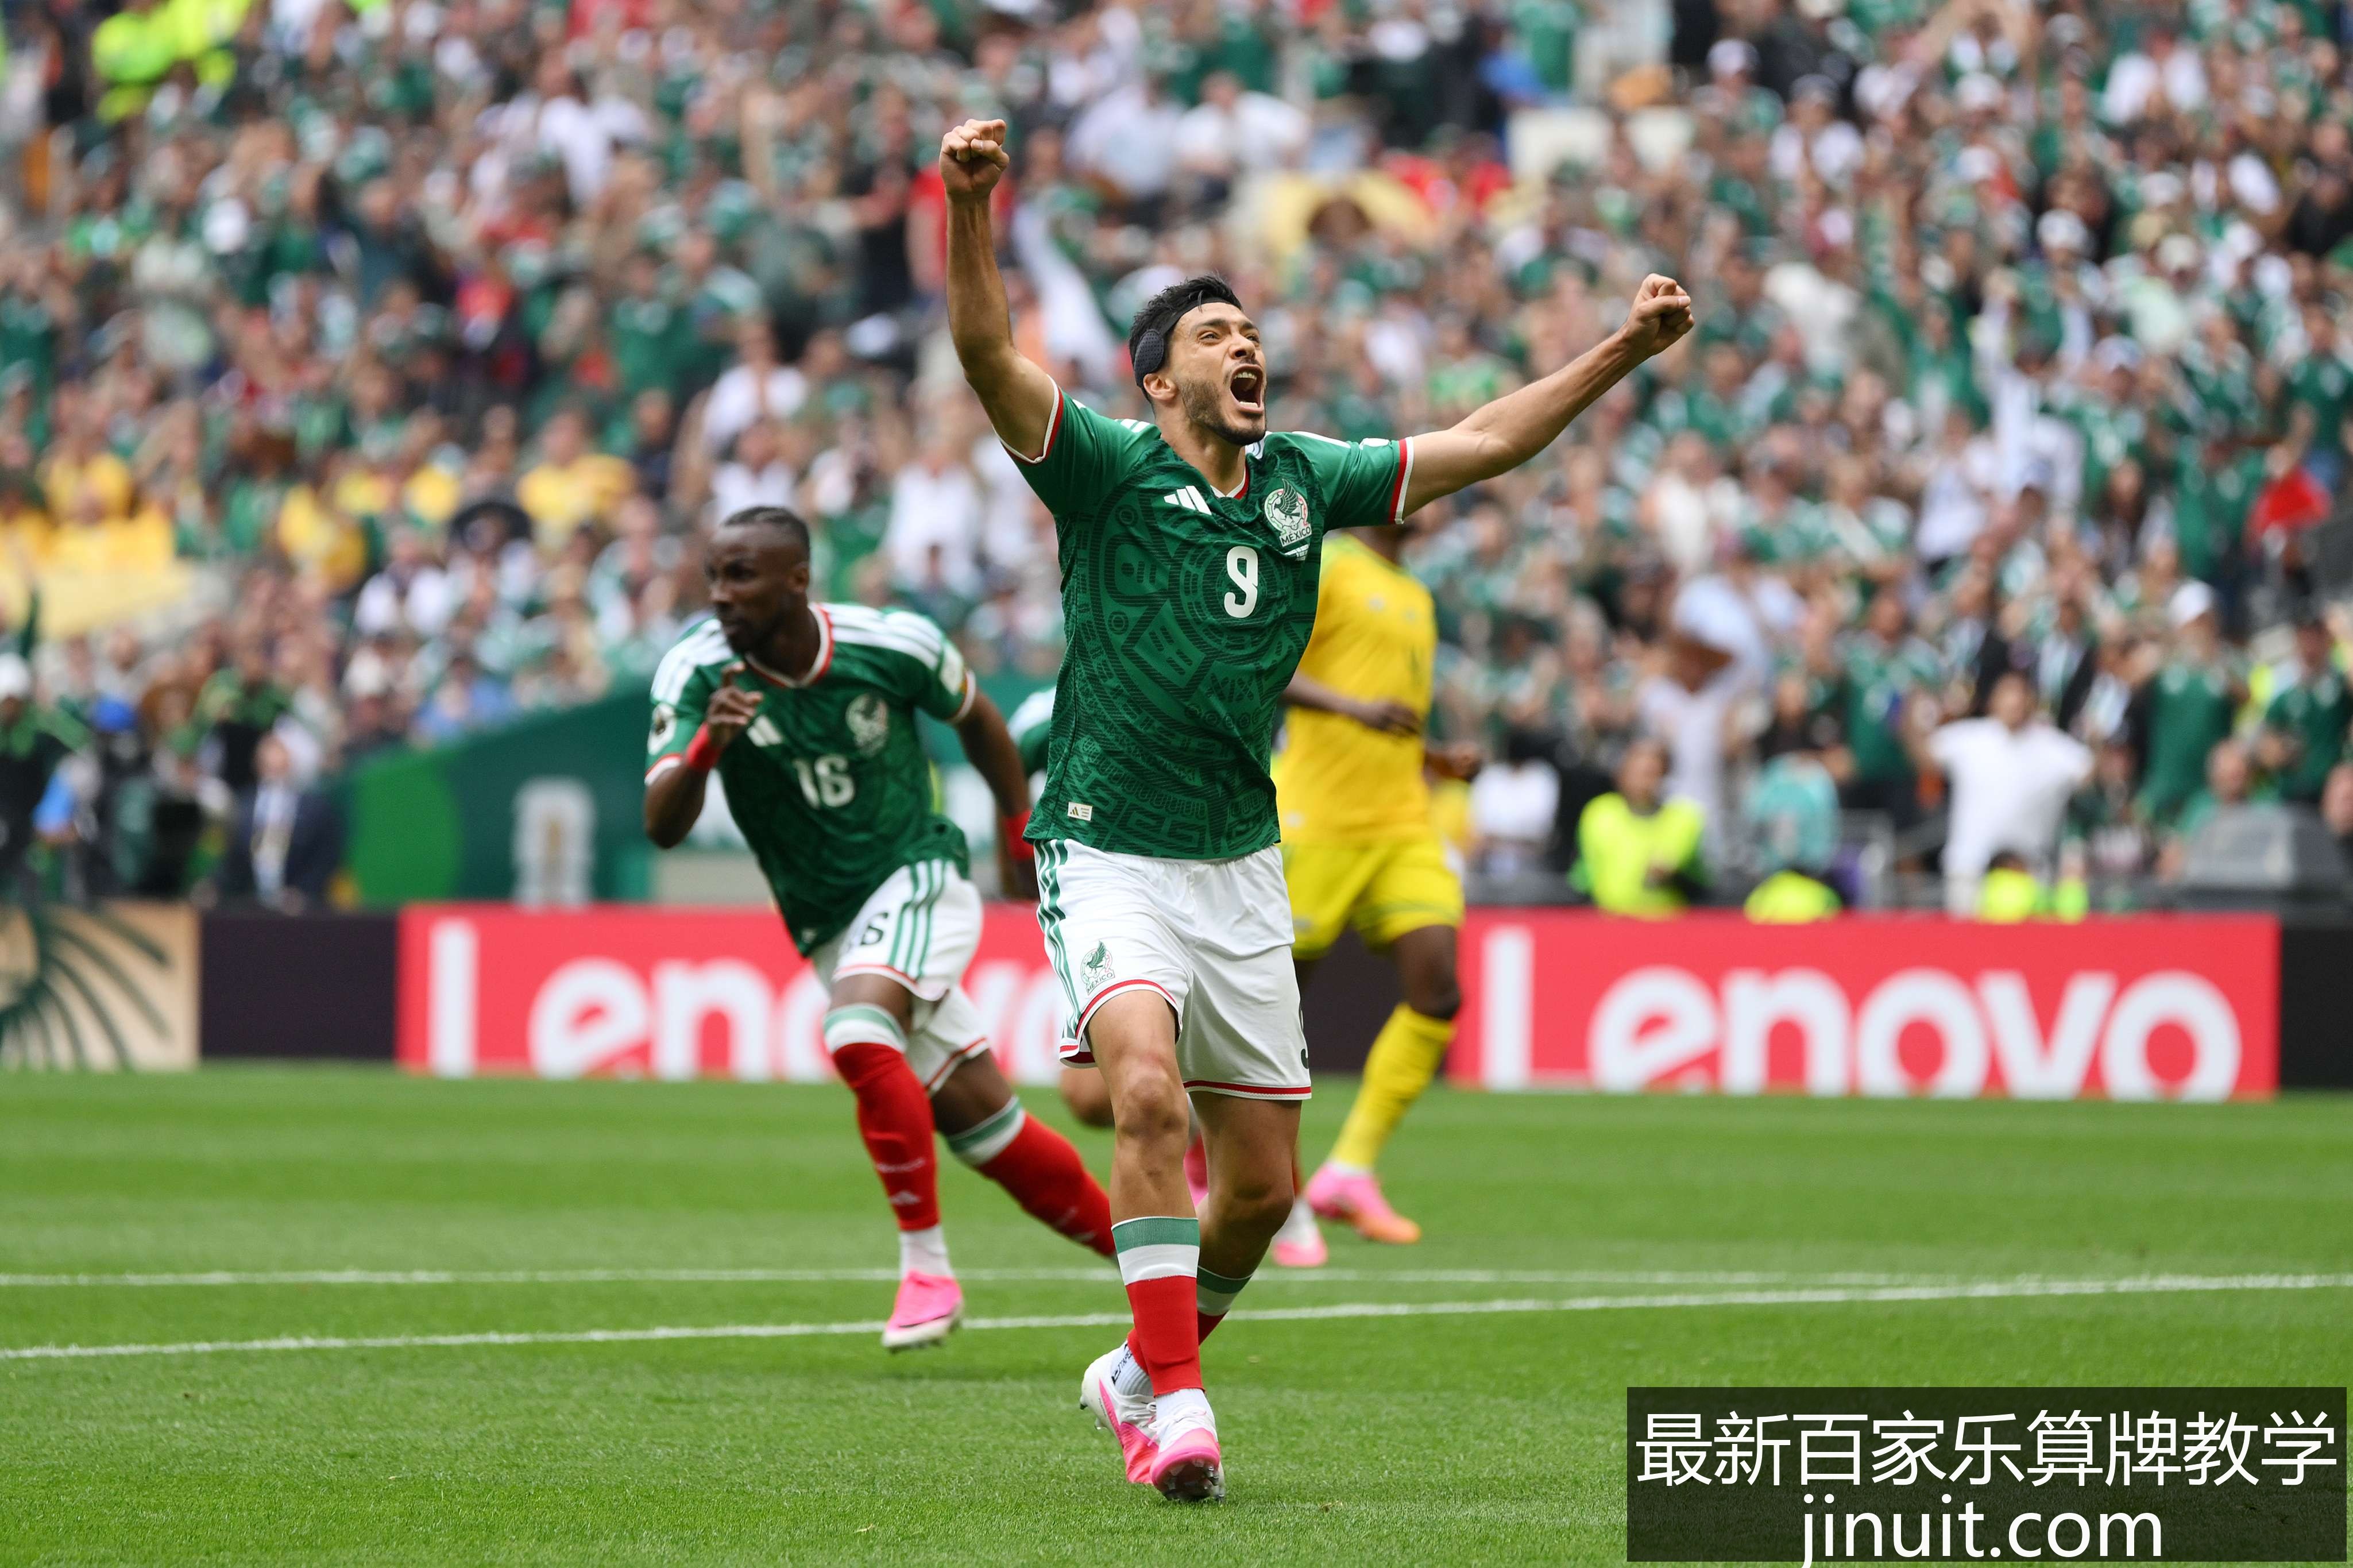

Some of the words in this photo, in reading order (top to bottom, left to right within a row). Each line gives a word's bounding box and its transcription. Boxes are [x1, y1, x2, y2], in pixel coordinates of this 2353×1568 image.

[1224, 546, 1258, 619] 9
[794, 754, 855, 809] 16
[1482, 926, 2242, 1102] Lenovo
